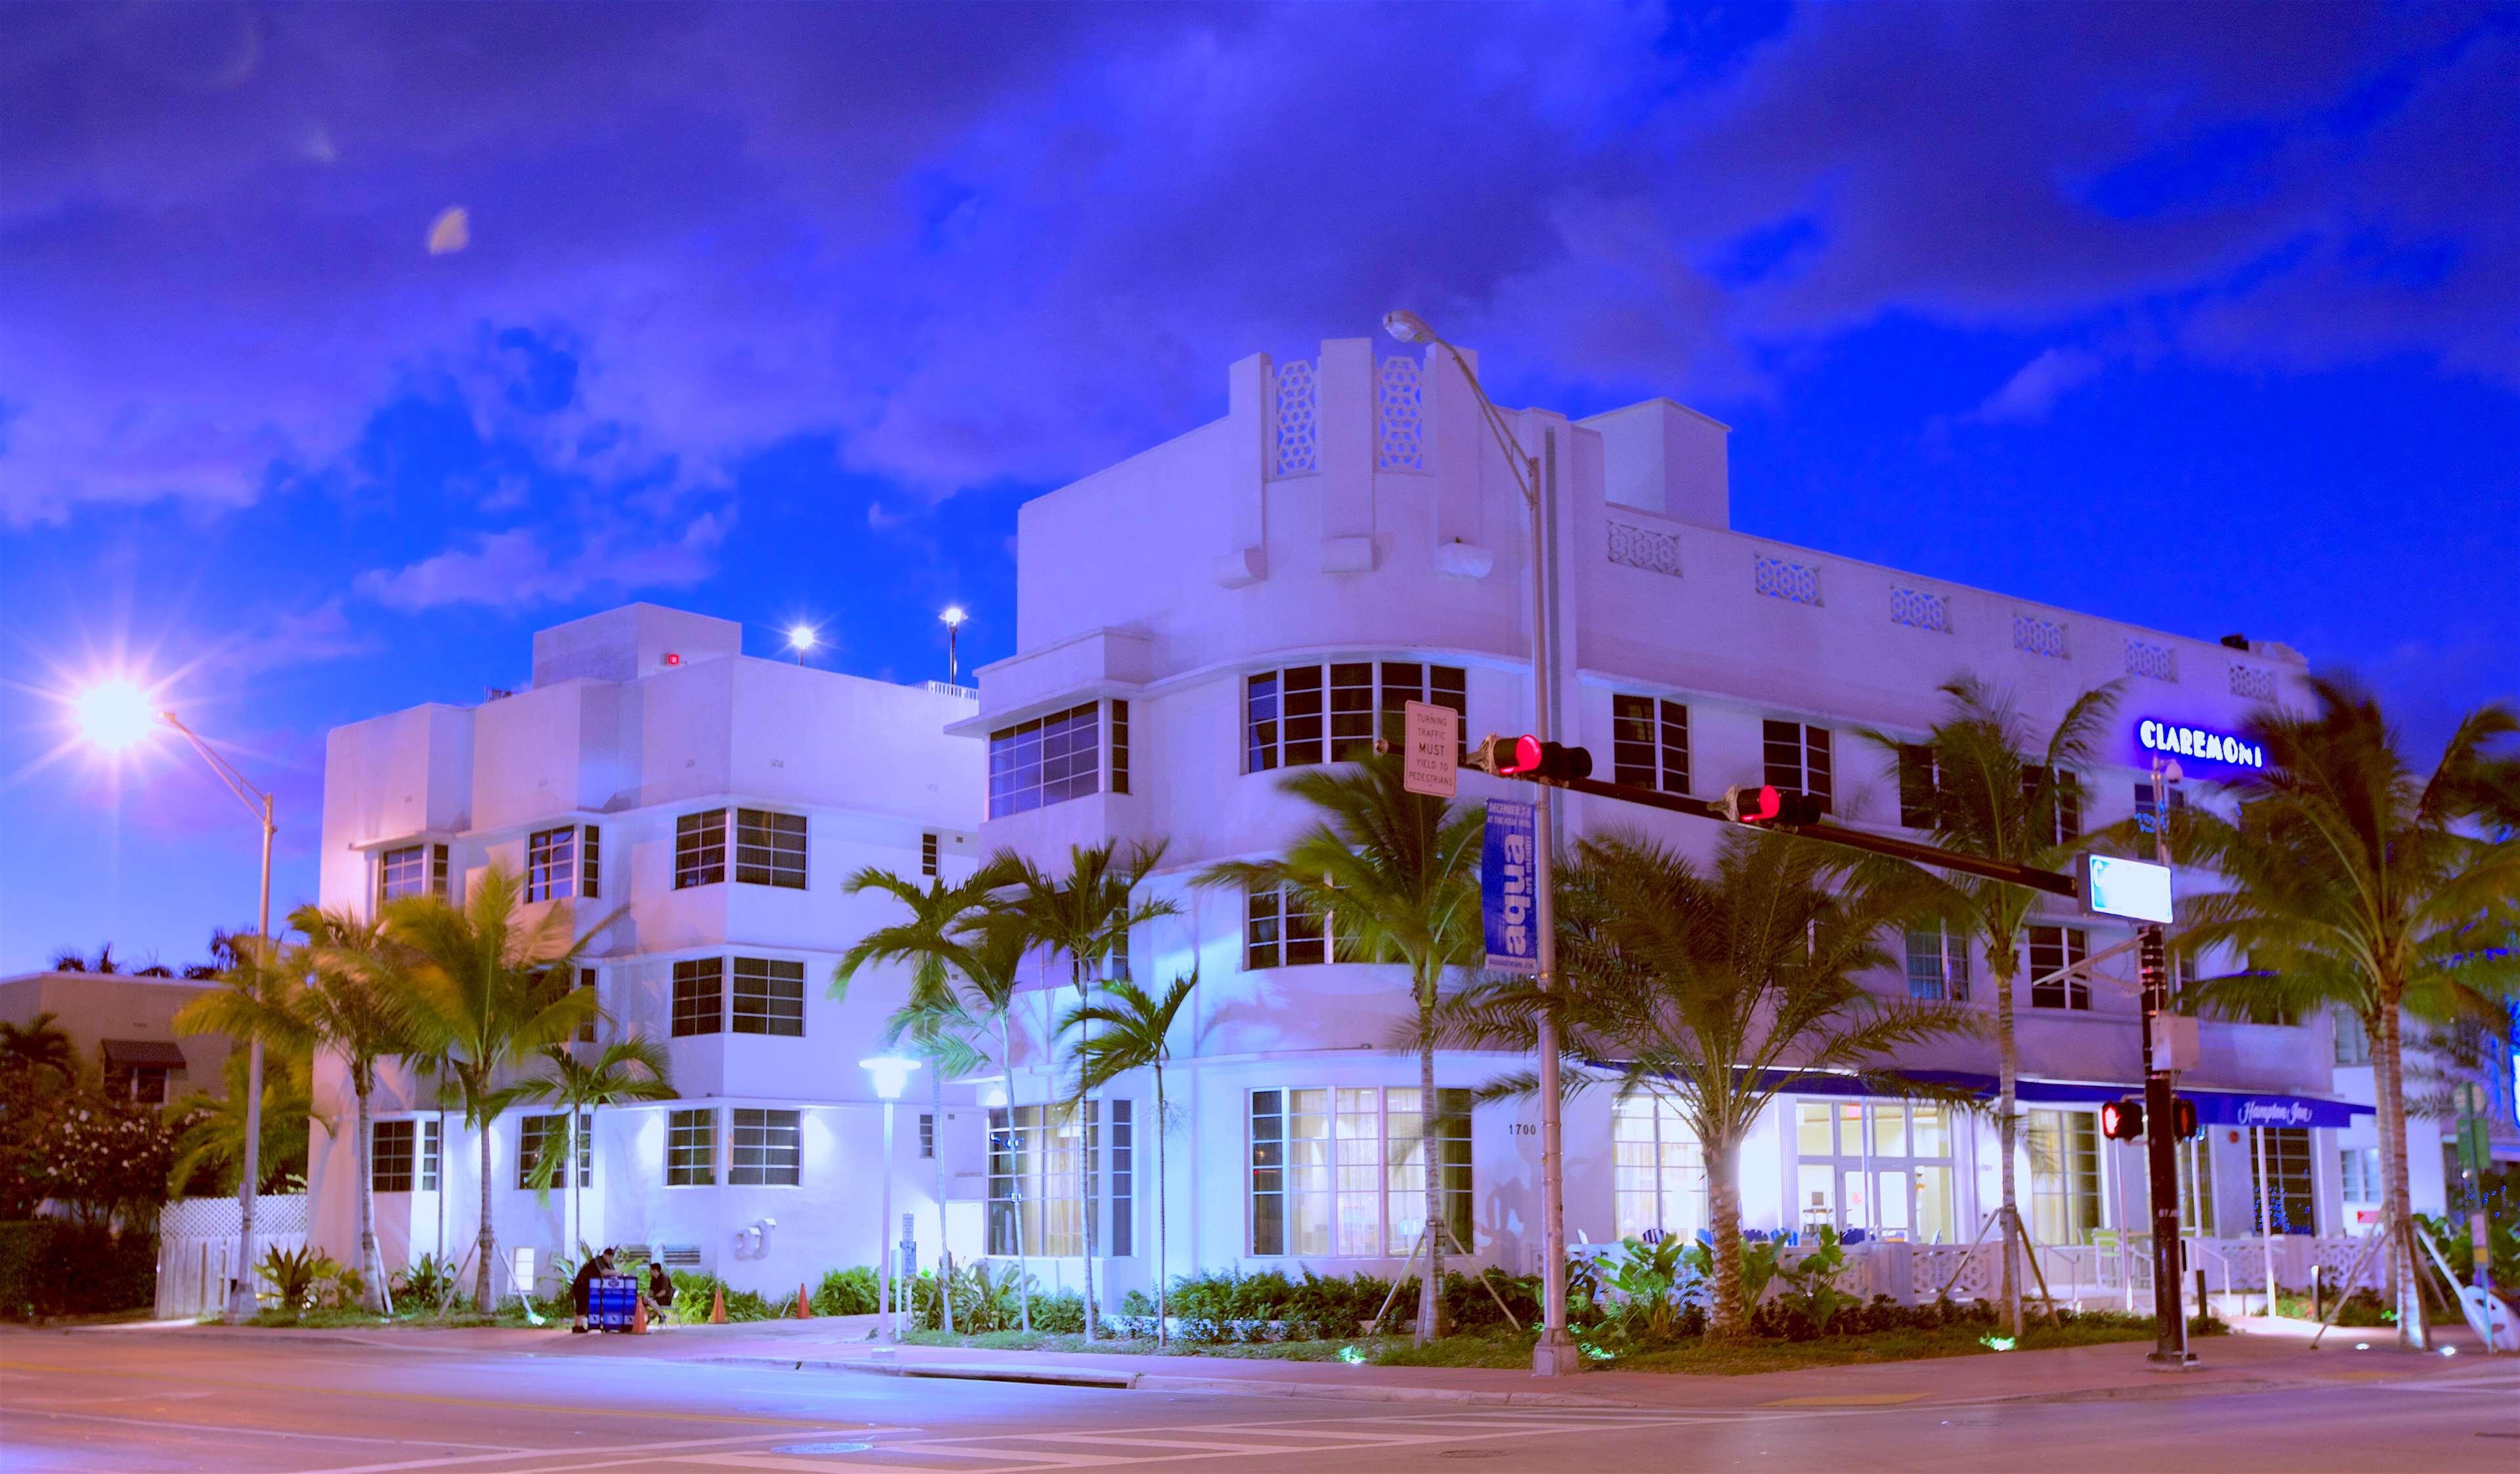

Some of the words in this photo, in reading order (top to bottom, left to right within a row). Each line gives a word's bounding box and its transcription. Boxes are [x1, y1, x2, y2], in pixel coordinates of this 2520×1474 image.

[1417, 713, 1447, 726] TURNING
[1418, 727, 1445, 740] TRAFFIC
[1419, 742, 1445, 756] MUST
[1417, 759, 1437, 770] YIELD
[1440, 762, 1449, 772] TO
[1409, 771, 1453, 786] PEDESTRIANS
[1503, 834, 1531, 956] aqua
[2238, 1101, 2287, 1125] Hampton
[2286, 1102, 2313, 1126] Inn
[1509, 1124, 1536, 1135] 1700
